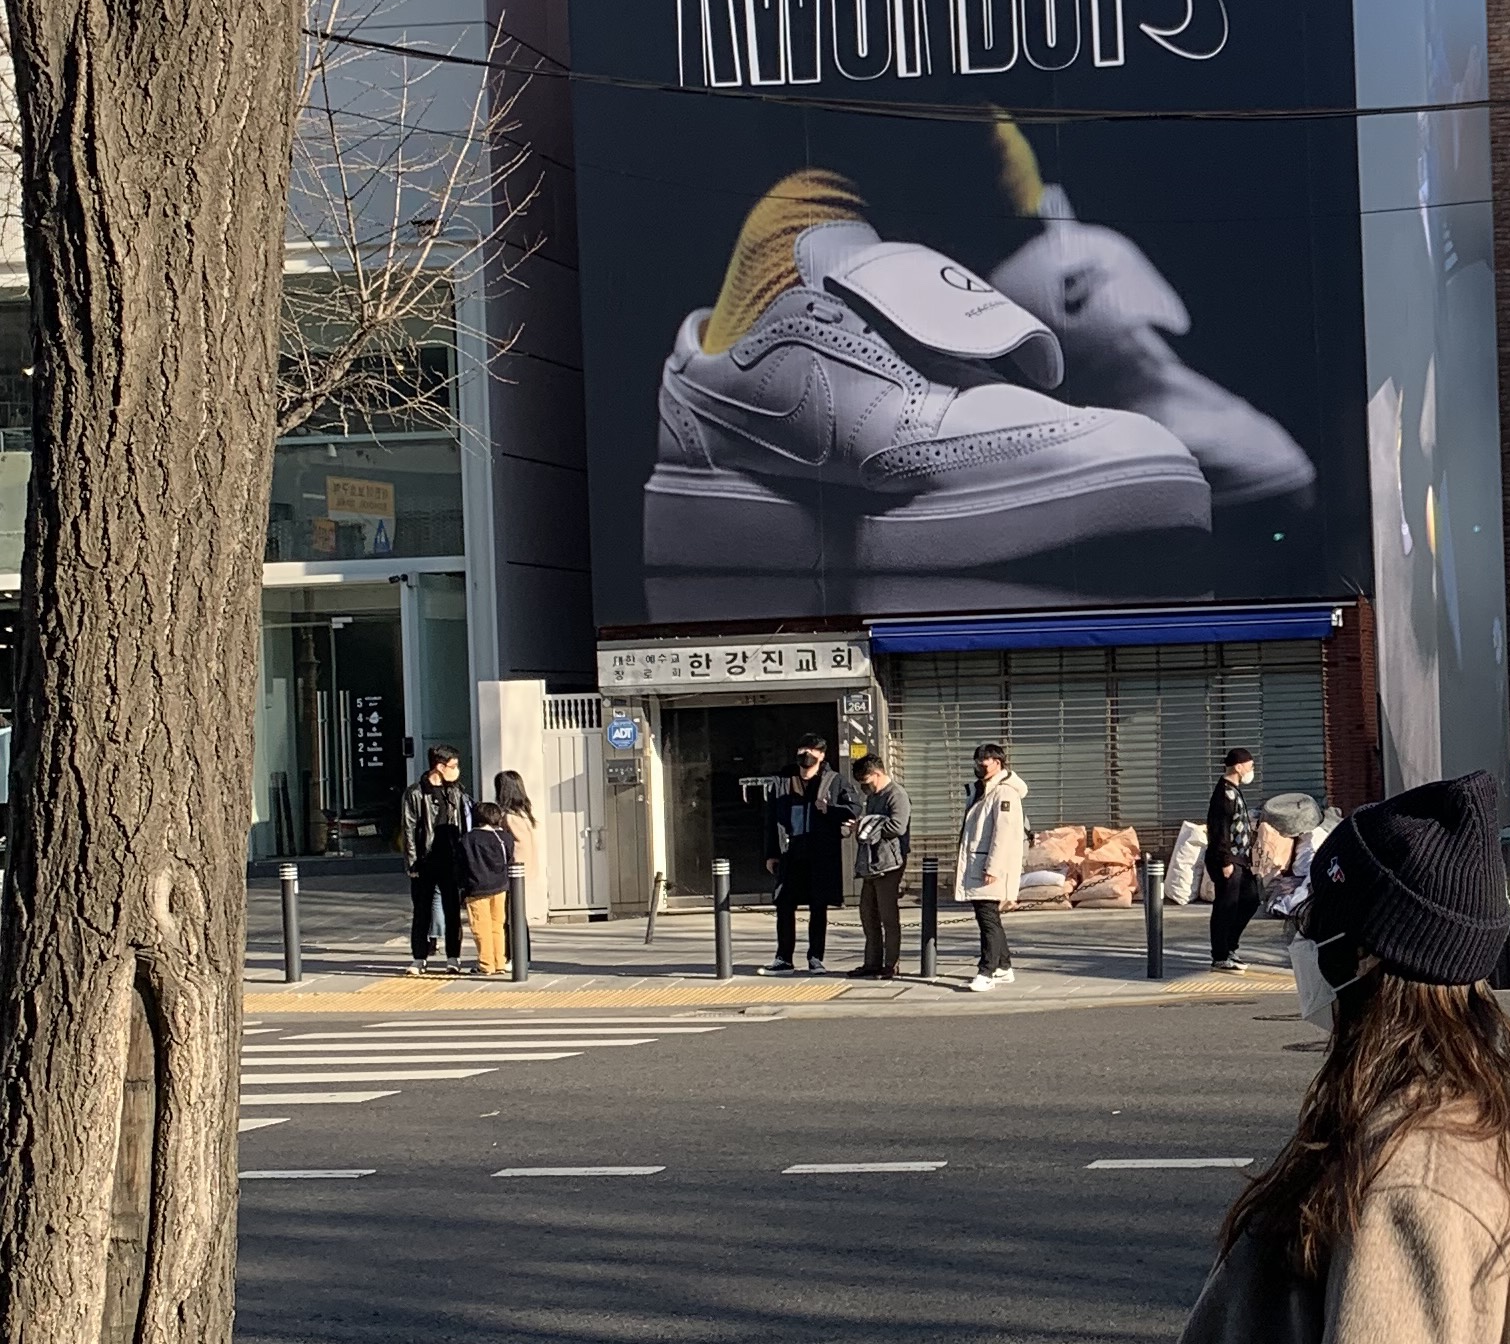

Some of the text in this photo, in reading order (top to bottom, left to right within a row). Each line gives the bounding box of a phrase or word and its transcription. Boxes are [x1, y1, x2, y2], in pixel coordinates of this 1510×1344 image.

[688, 647, 853, 678] 한강진교회
[356, 698, 363, 708] 5
[848, 702, 866, 712] 264
[356, 712, 363, 723] 4
[357, 727, 364, 738] 3
[612, 727, 633, 739] ADT
[358, 742, 364, 752] 2
[358, 757, 364, 767] 1
